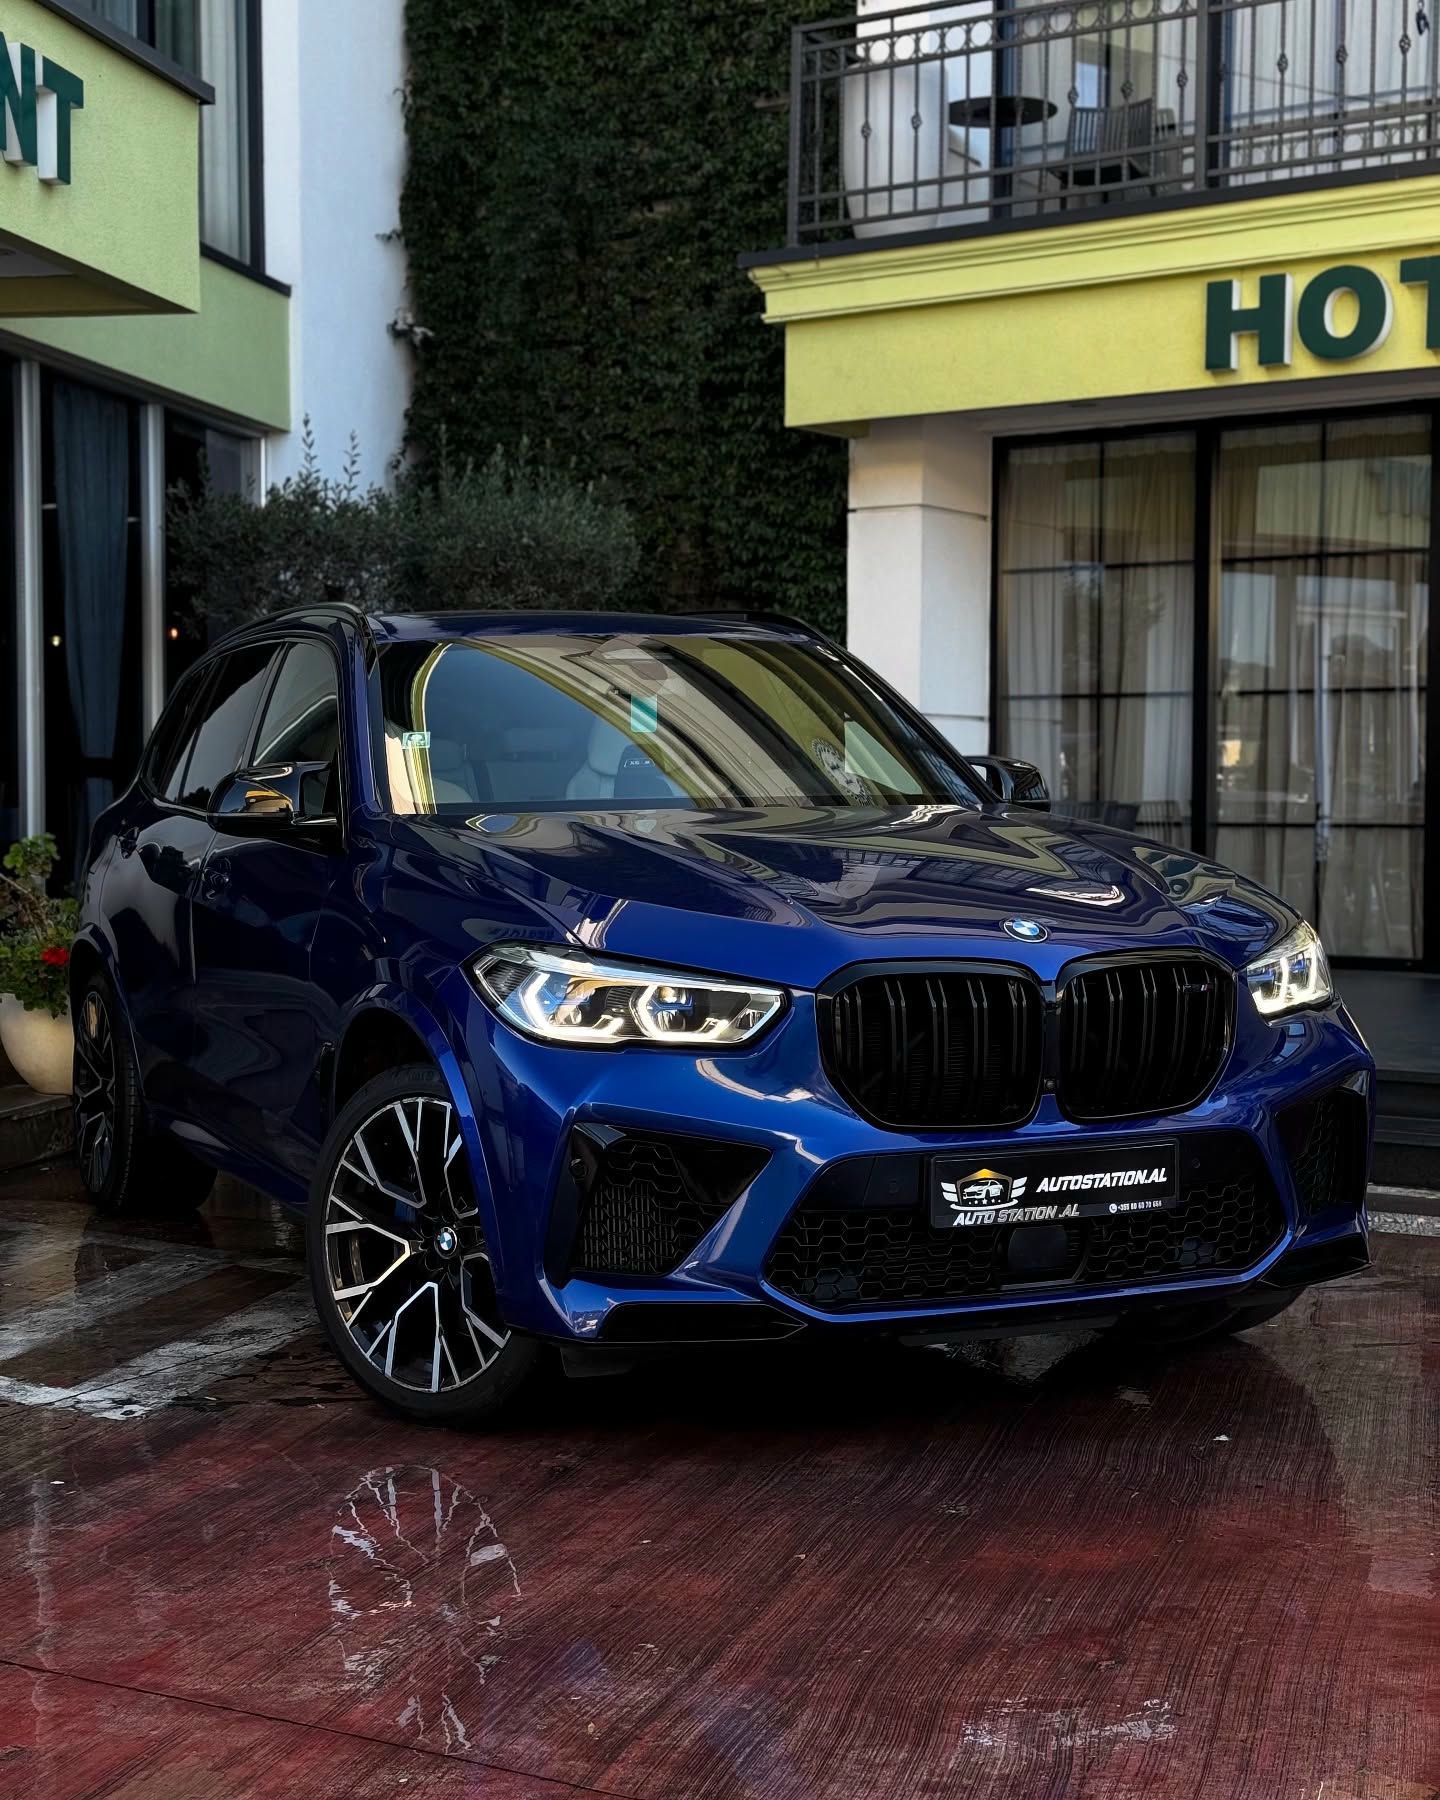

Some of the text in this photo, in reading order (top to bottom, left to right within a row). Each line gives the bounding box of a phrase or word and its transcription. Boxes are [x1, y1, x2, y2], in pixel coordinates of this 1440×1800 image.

[1036, 1167, 1168, 1193] AUTOSTATION.AL
[952, 1211, 996, 1226] AUTO
[998, 1205, 1058, 1223] STATION
